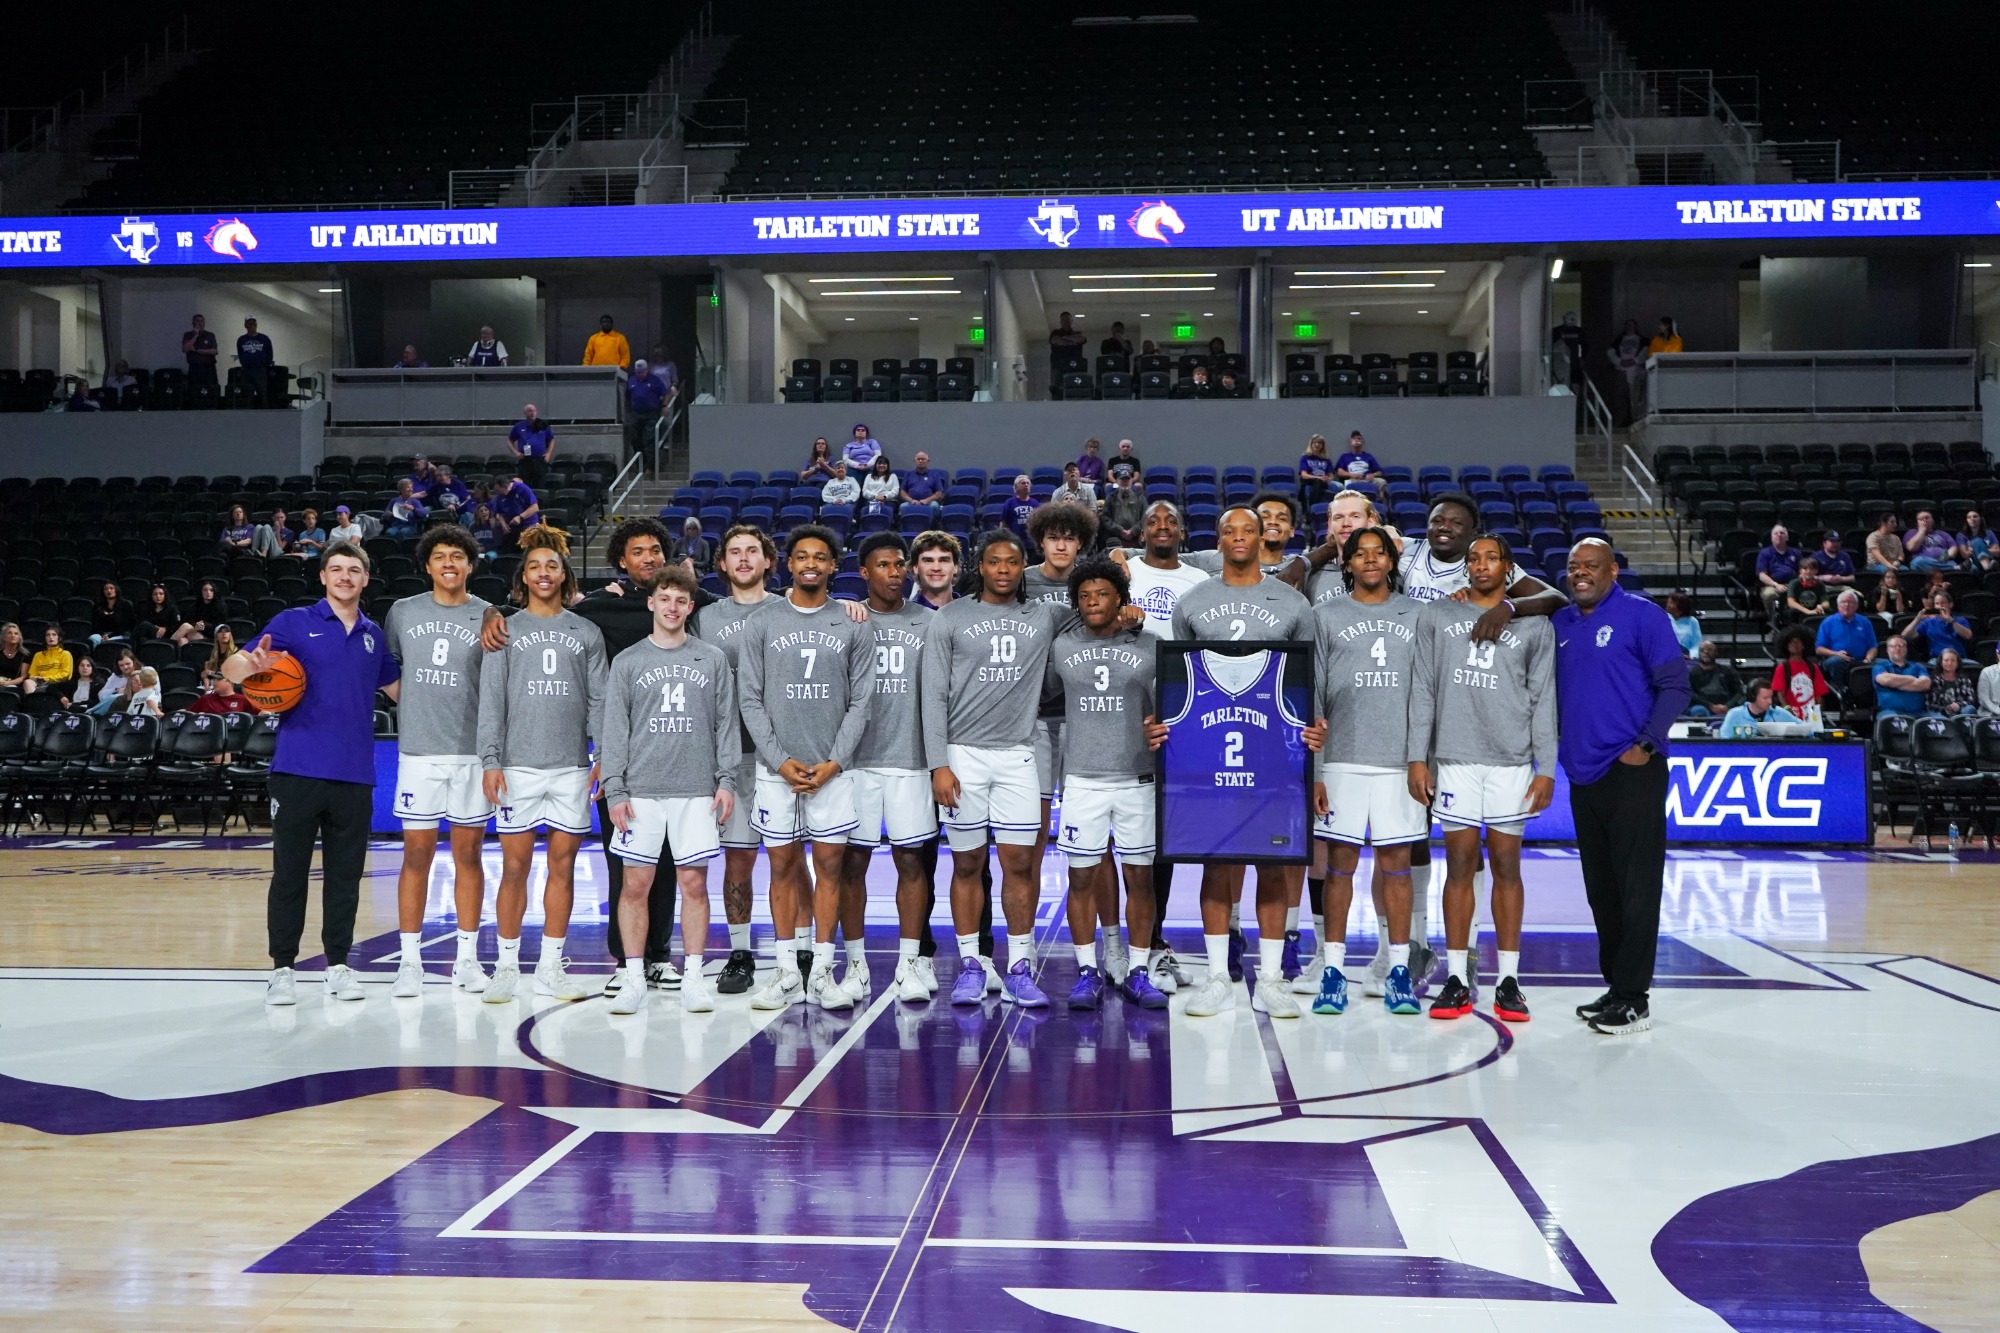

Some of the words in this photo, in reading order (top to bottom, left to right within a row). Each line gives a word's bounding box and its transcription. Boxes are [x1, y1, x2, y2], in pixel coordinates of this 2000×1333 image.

[1097, 213, 1116, 232] VS
[1240, 208, 1280, 233] UT
[1285, 204, 1445, 232] ARLINGTON
[1676, 198, 1825, 224] TARLETON
[1831, 197, 1922, 222] STATE
[309, 224, 347, 248] UT
[351, 222, 499, 247] ARLINGTON
[753, 213, 891, 240] TARLETON
[896, 212, 981, 238] STATE
[0, 230, 62, 254] TATE
[176, 230, 194, 248] VS
[1131, 597, 1168, 609] ARLETON
[1198, 601, 1281, 629] TARLETON
[405, 620, 481, 649] TARLETON
[873, 627, 926, 652] LETON
[962, 618, 1038, 640] TARLETON
[1337, 619, 1414, 644] TARLETON
[1443, 620, 1521, 650] TARON
[431, 638, 450, 667] 8
[512, 630, 585, 656] TARLETON
[770, 630, 846, 655] TARLETON
[988, 634, 1017, 663] 10
[1369, 636, 1388, 667] 4
[1465, 640, 1497, 670] 13
[799, 648, 817, 679] 7
[875, 645, 905, 675] 30
[1064, 646, 1143, 670] TARLETON
[415, 668, 459, 688] STATE
[635, 663, 710, 689] TARLETON
[875, 678, 908, 694] TATE
[978, 666, 1022, 683] STATE
[1093, 665, 1111, 692] 3
[1354, 671, 1399, 688] STATE
[1453, 668, 1499, 690] STATE
[527, 680, 569, 697] STATE
[660, 682, 686, 713] 14
[786, 683, 830, 700] STATE
[1079, 696, 1125, 713] STATE
[648, 716, 694, 734] STATE
[1200, 706, 1269, 731] TARLETON
[1224, 731, 1245, 768] 2
[1214, 771, 1256, 788] STATE
[1665, 756, 1828, 827] WAC
